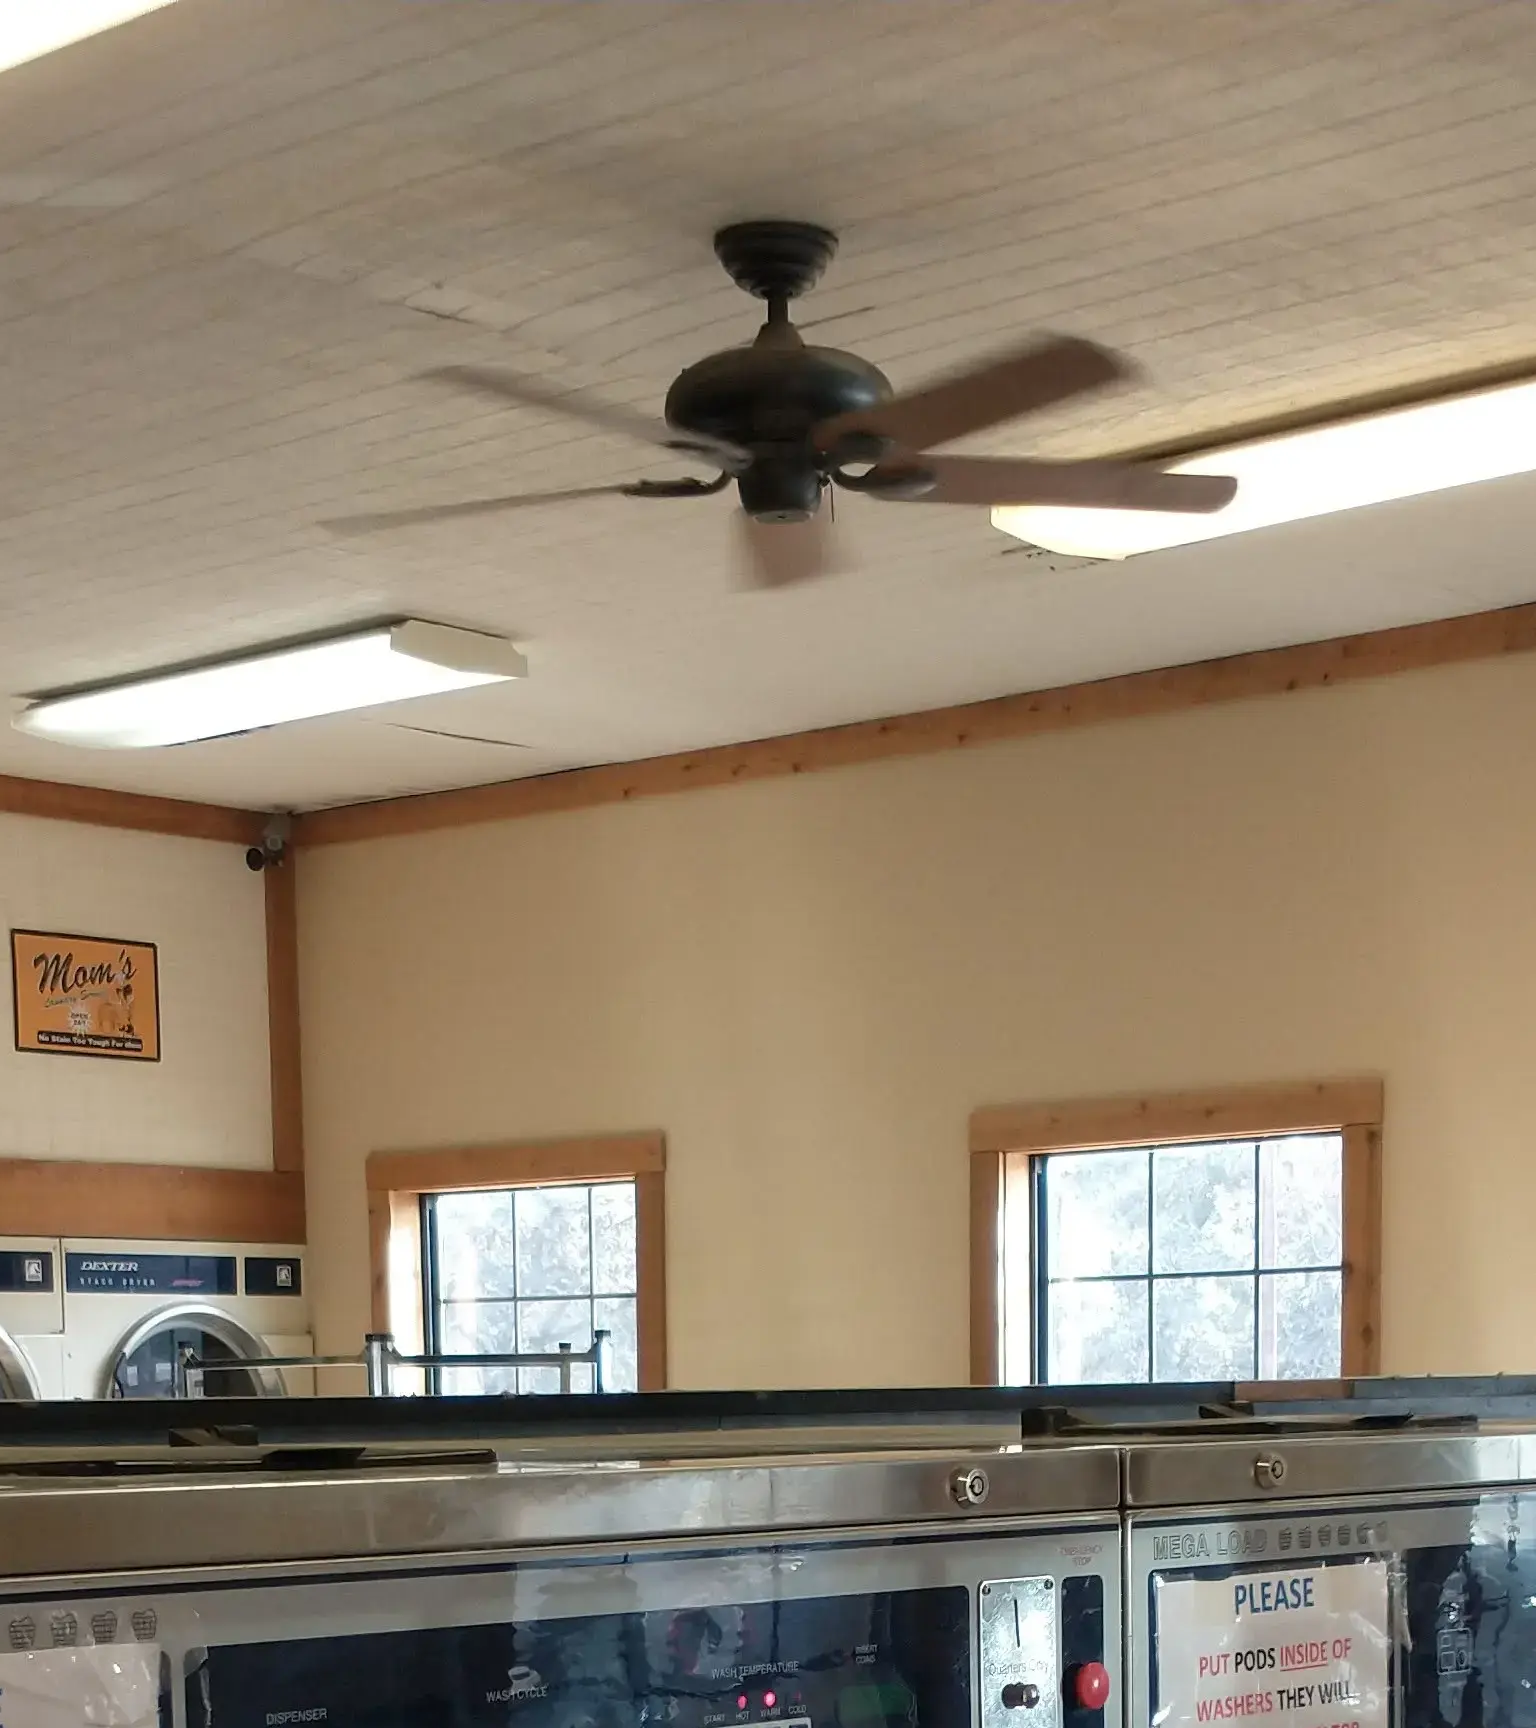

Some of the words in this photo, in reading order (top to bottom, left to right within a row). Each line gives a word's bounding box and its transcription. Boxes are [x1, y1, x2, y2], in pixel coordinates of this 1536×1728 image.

[33, 949, 137, 994] Mom's
[80, 1261, 139, 1272] DEXTER
[1153, 1532, 1210, 1561] MEGA
[1216, 1530, 1268, 1556] LOAD
[1235, 1577, 1315, 1616] PLEASE
[712, 1668, 737, 1680] WASH
[739, 1660, 800, 1677] TEMPERATURE
[1199, 1653, 1231, 1679] PUT
[1234, 1647, 1276, 1674] PODS
[1280, 1640, 1329, 1669] INSIDE
[1332, 1637, 1352, 1660] OF
[518, 1684, 550, 1700] CYCLE
[1196, 1691, 1274, 1723] WASHERS
[1277, 1684, 1315, 1711] THEY
[1318, 1680, 1354, 1704] WILL
[266, 1707, 328, 1726] DISPENSER
[735, 1710, 751, 1720] HOT
